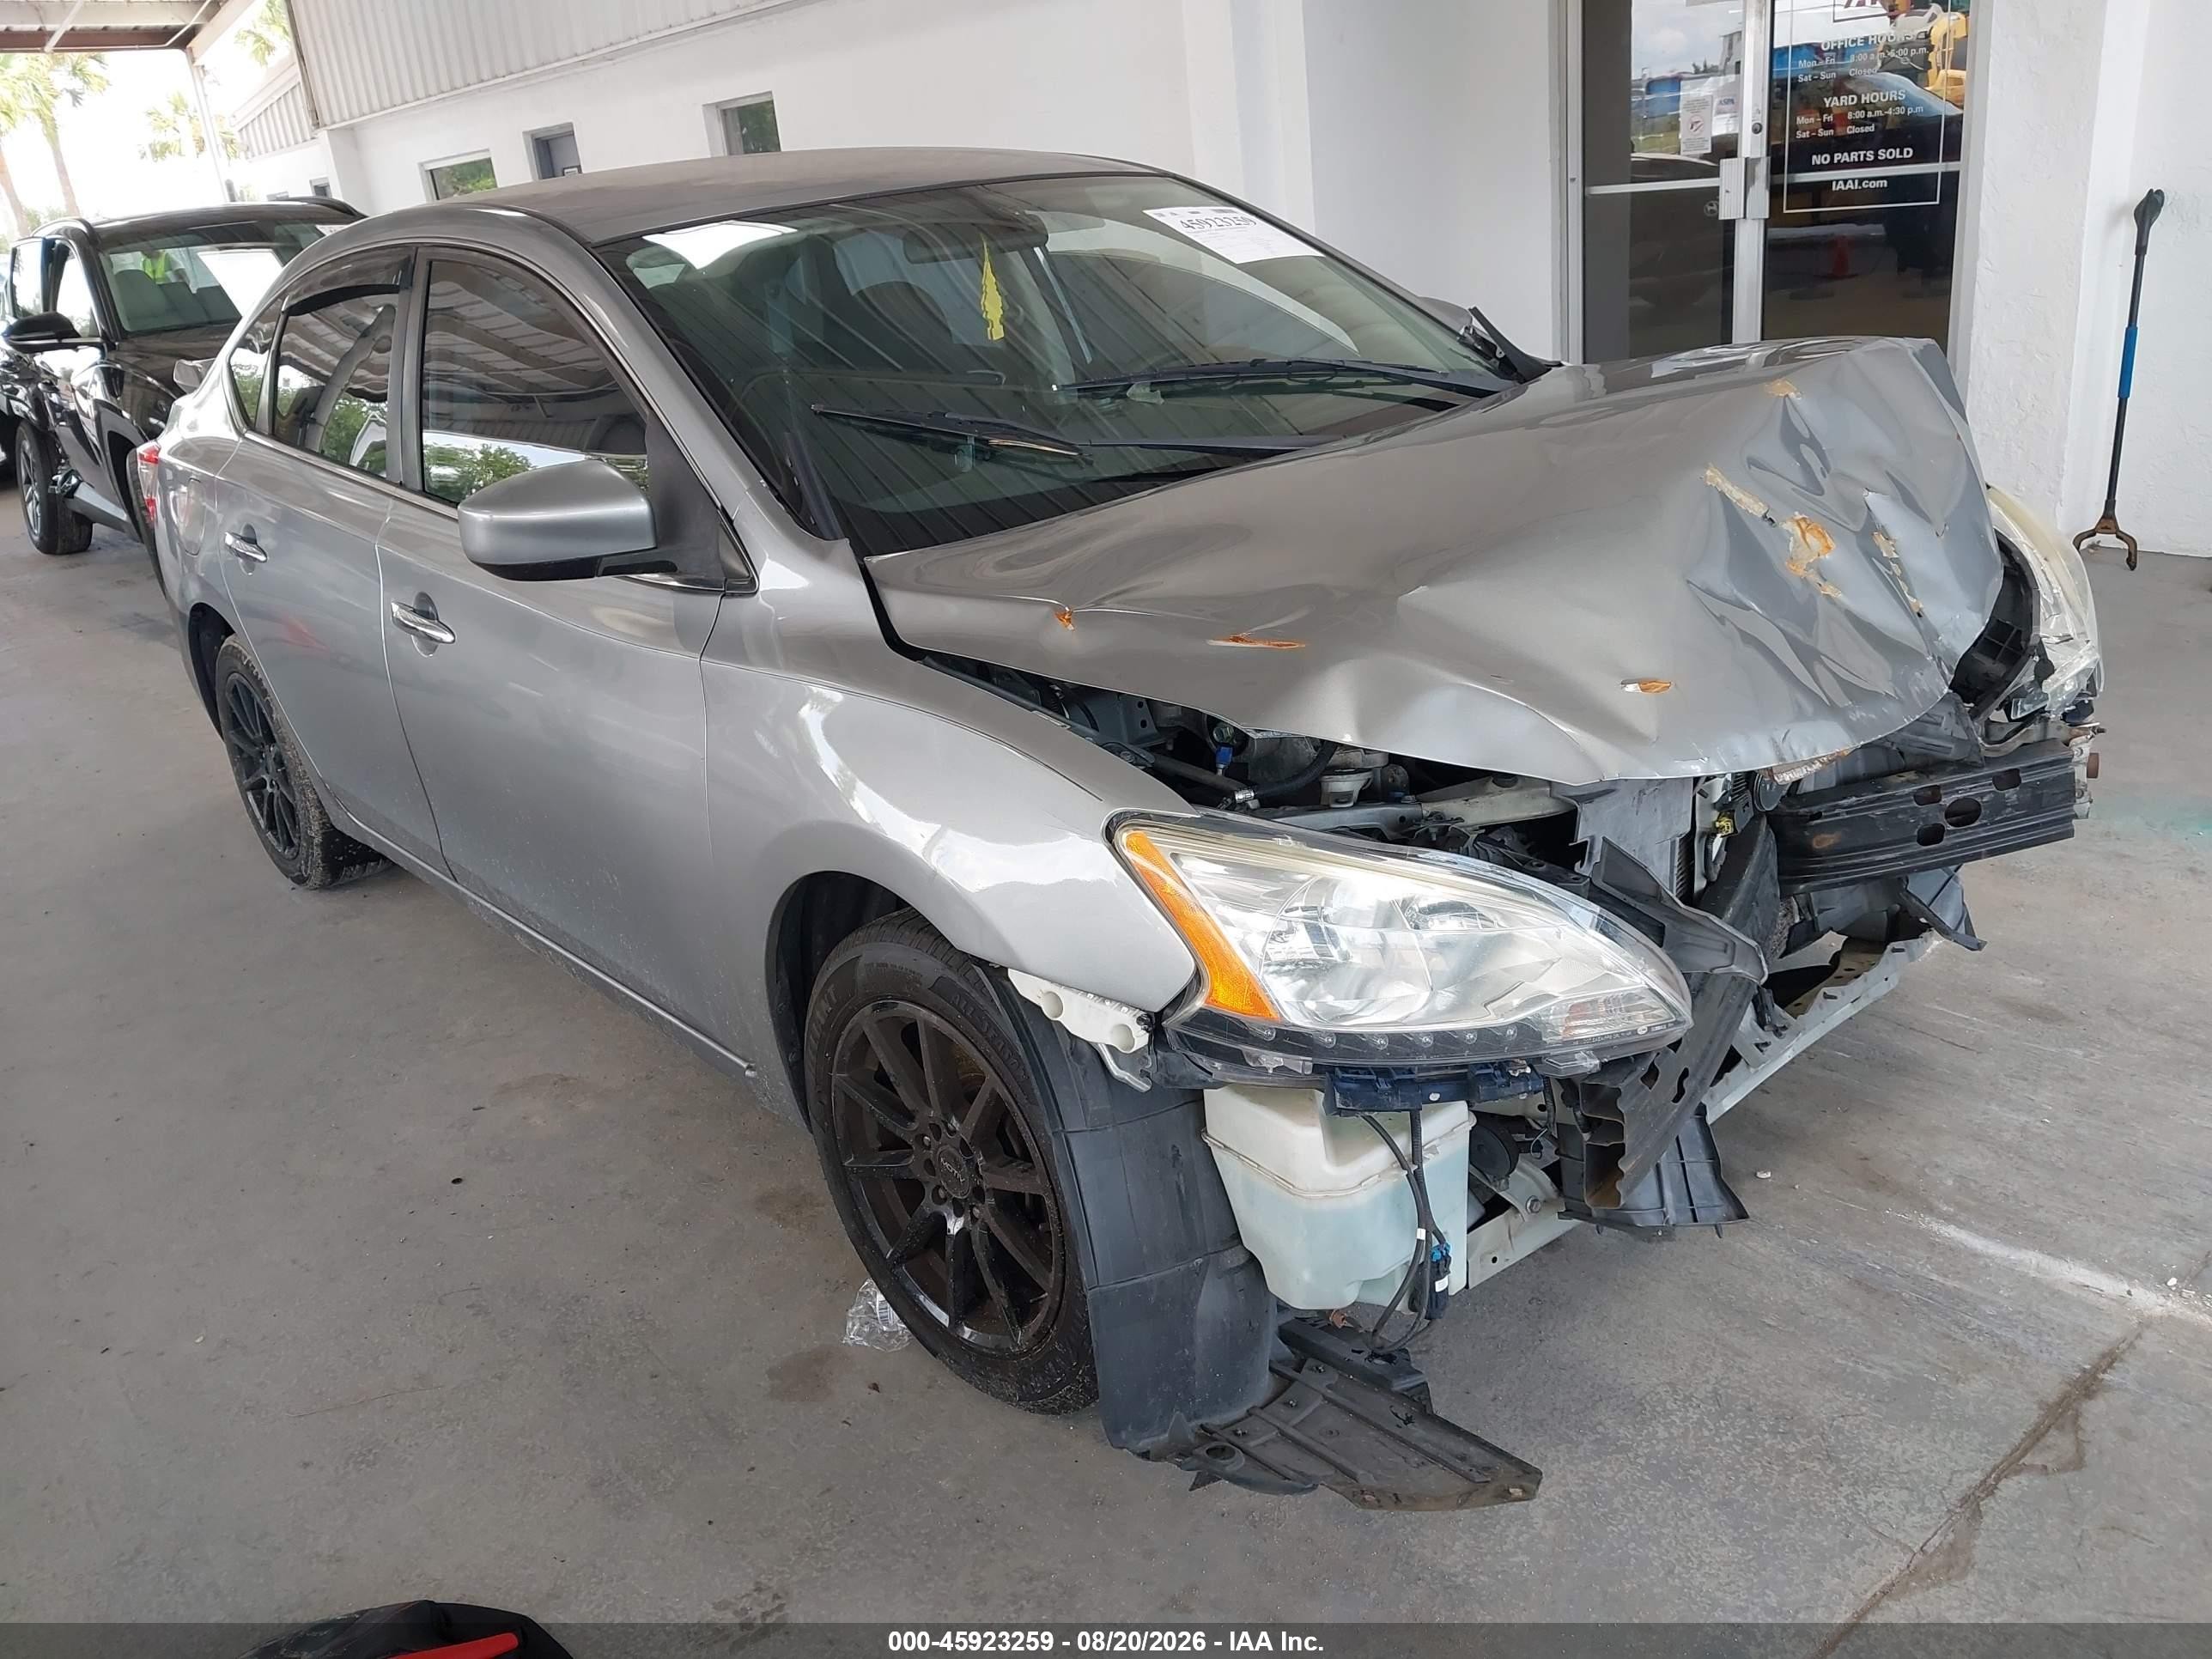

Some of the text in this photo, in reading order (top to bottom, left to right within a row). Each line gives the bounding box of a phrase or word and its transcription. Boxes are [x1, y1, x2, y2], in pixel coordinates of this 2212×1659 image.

[1820, 37, 1865, 52] OFFICE
[1910, 47, 1929, 58] p.m.
[1798, 60, 1814, 69] Mon
[1825, 57, 1836, 65] Fri
[1797, 74, 1813, 83] Sat
[1820, 71, 1837, 81] Sun
[1824, 89, 1906, 107] YARD HOURS
[1796, 116, 1814, 125] Mon
[1822, 113, 1833, 123] Fri
[1847, 110, 1865, 120] 8:00
[1867, 106, 1905, 118] a.m.-4:30
[1796, 131, 1810, 139] Sat
[1817, 129, 1834, 137] Sun
[1846, 124, 1875, 135] Closed
[1811, 147, 1913, 166] NO PARTS SOLD
[1832, 179, 1888, 191] IAAI.com
[1179, 216, 1257, 230] 45923259
